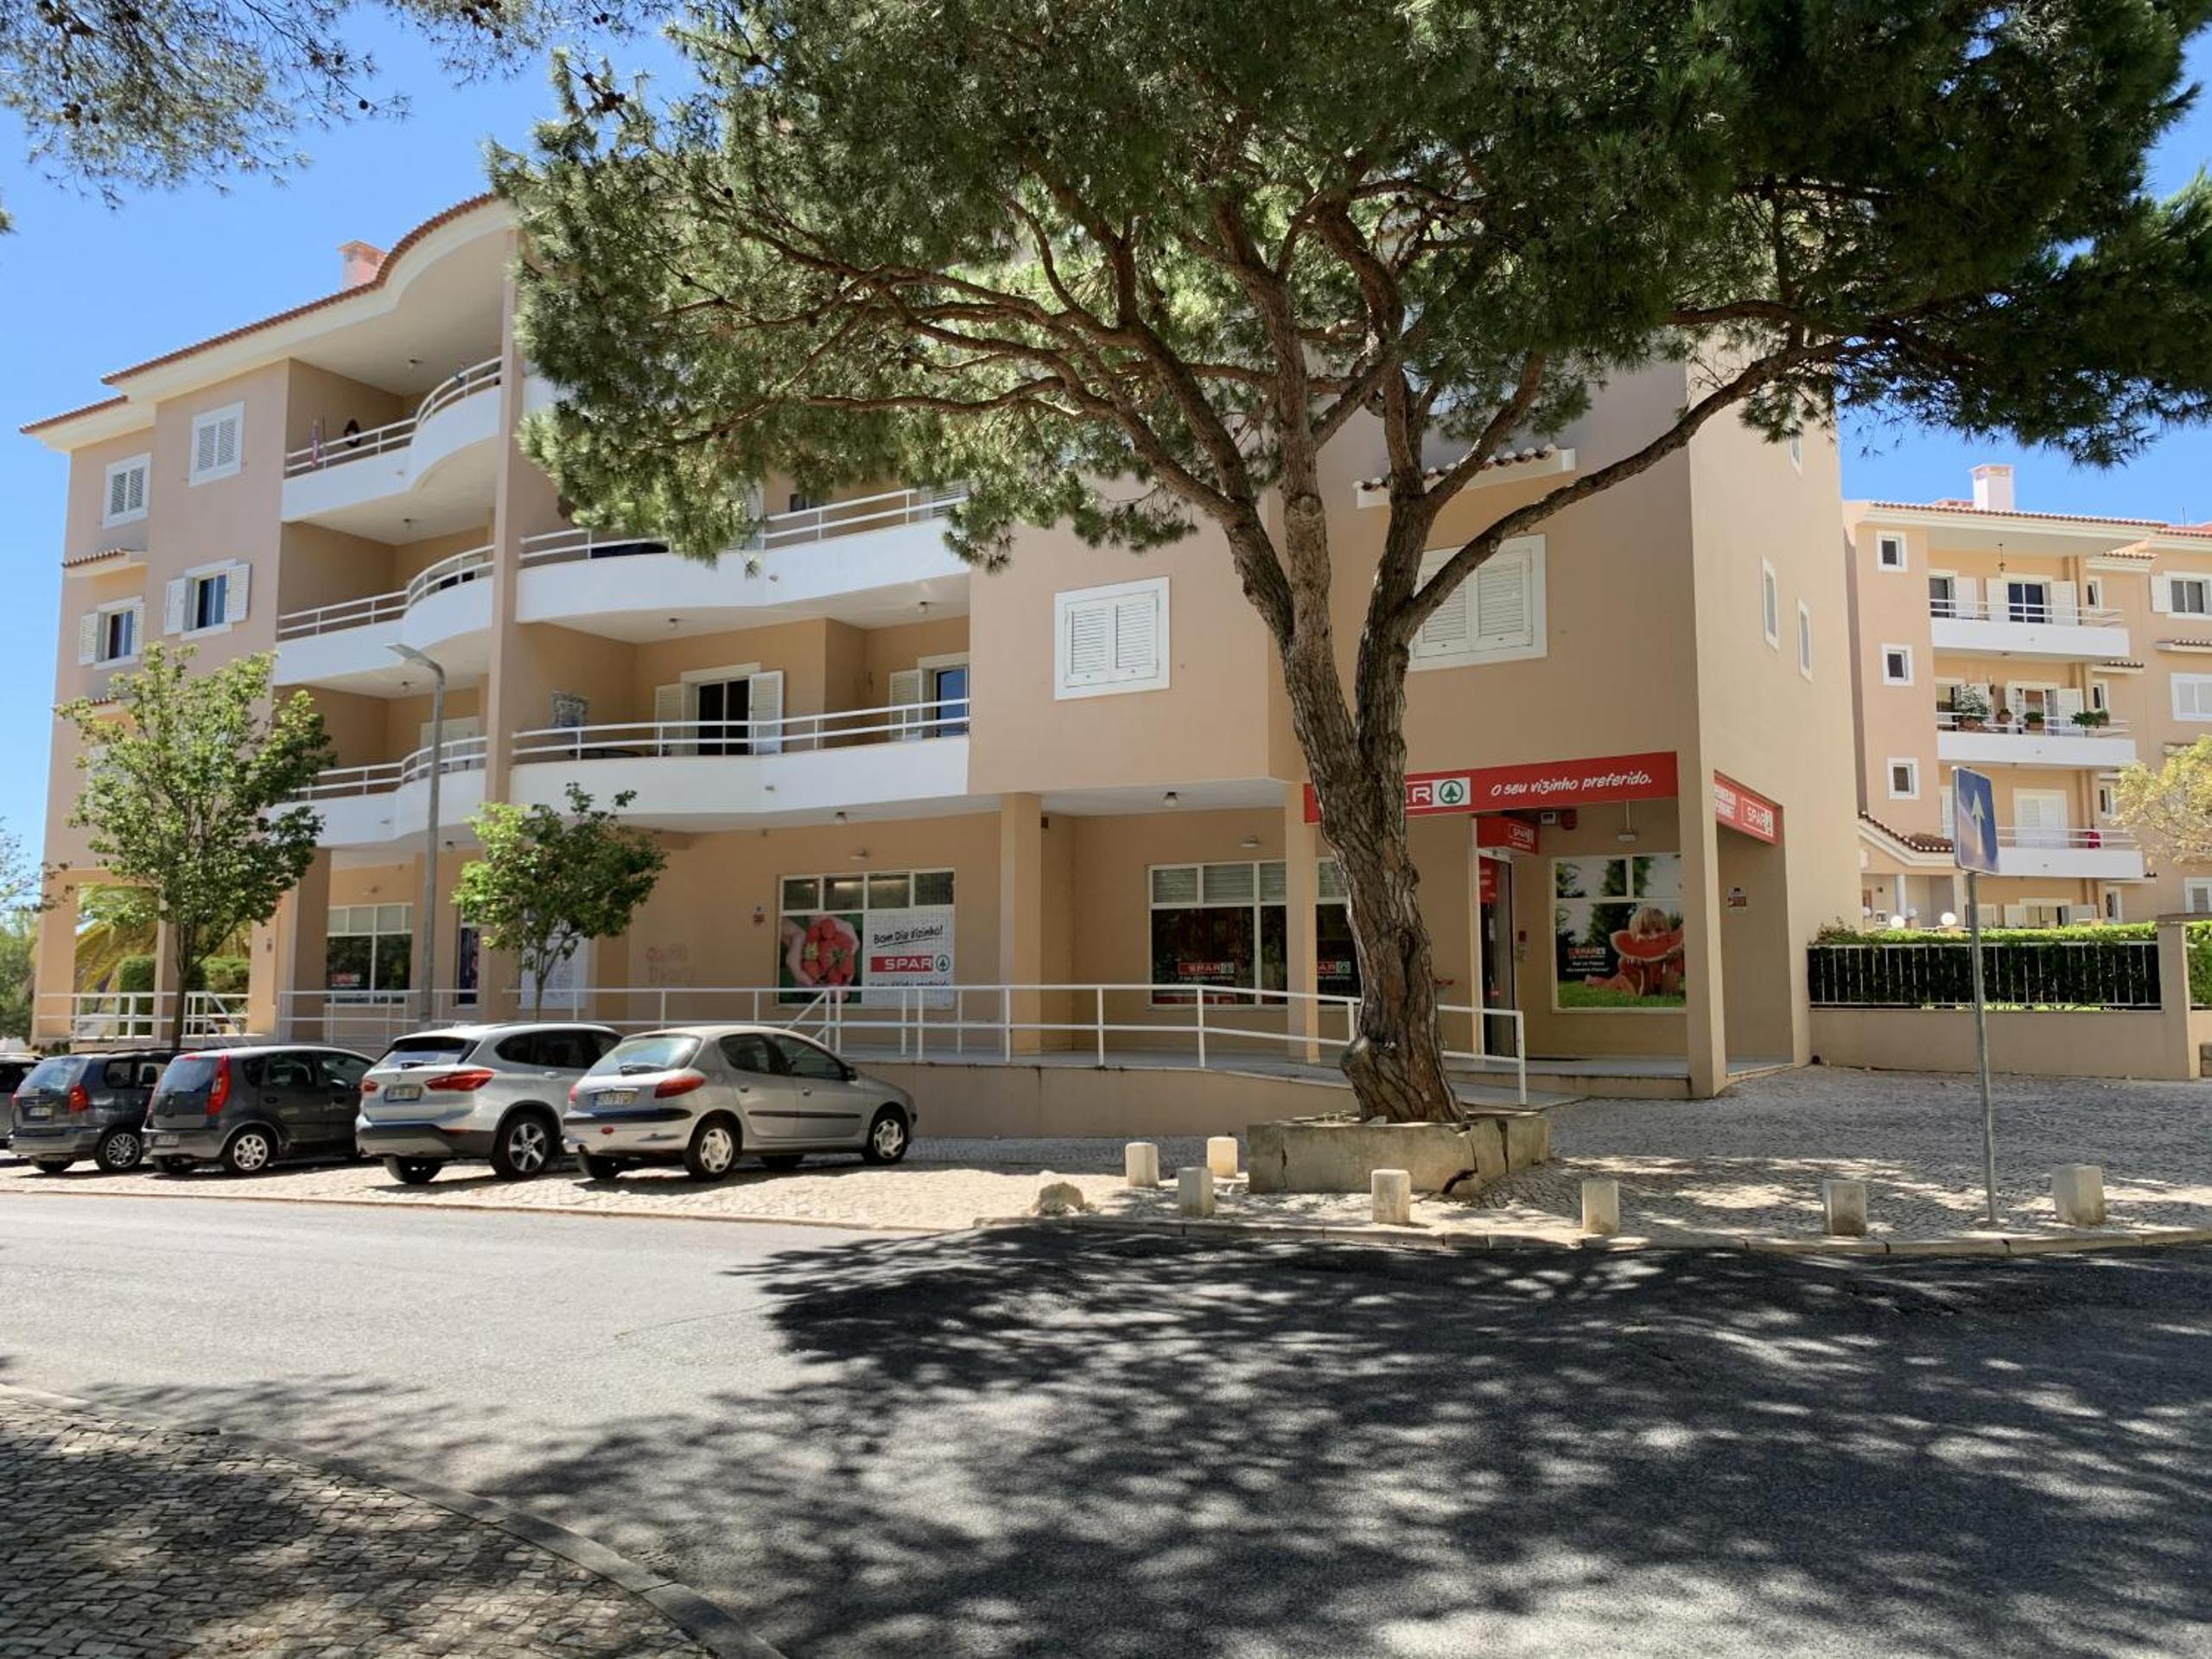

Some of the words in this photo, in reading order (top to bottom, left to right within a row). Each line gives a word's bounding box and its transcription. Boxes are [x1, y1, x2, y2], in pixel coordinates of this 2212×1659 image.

[1491, 784, 1503, 796] O
[1503, 784, 1527, 794] seu
[1530, 777, 1579, 794] vizinho
[1582, 770, 1653, 791] preferido.
[874, 933, 893, 944] Bom
[884, 957, 932, 969] SPAR
